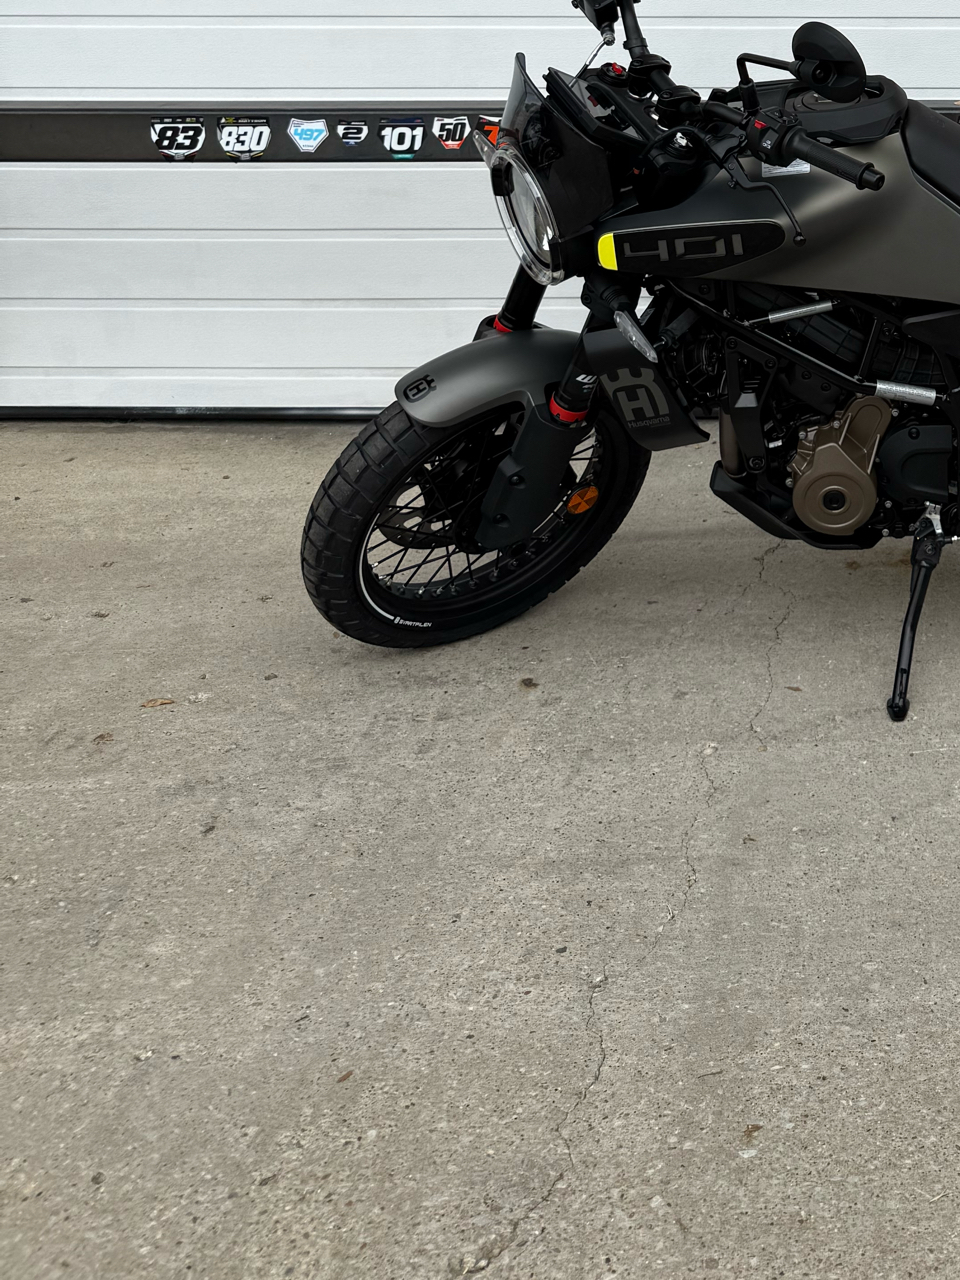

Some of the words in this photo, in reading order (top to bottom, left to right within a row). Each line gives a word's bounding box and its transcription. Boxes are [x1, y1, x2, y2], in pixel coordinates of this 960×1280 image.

[155, 126, 203, 151] 83
[220, 126, 271, 151] 830
[293, 128, 325, 141] 497
[342, 126, 364, 140] 2
[381, 127, 424, 151] 101
[438, 122, 467, 142] 50
[623, 233, 744, 262] 401
[627, 416, 670, 429] Husqvarna
